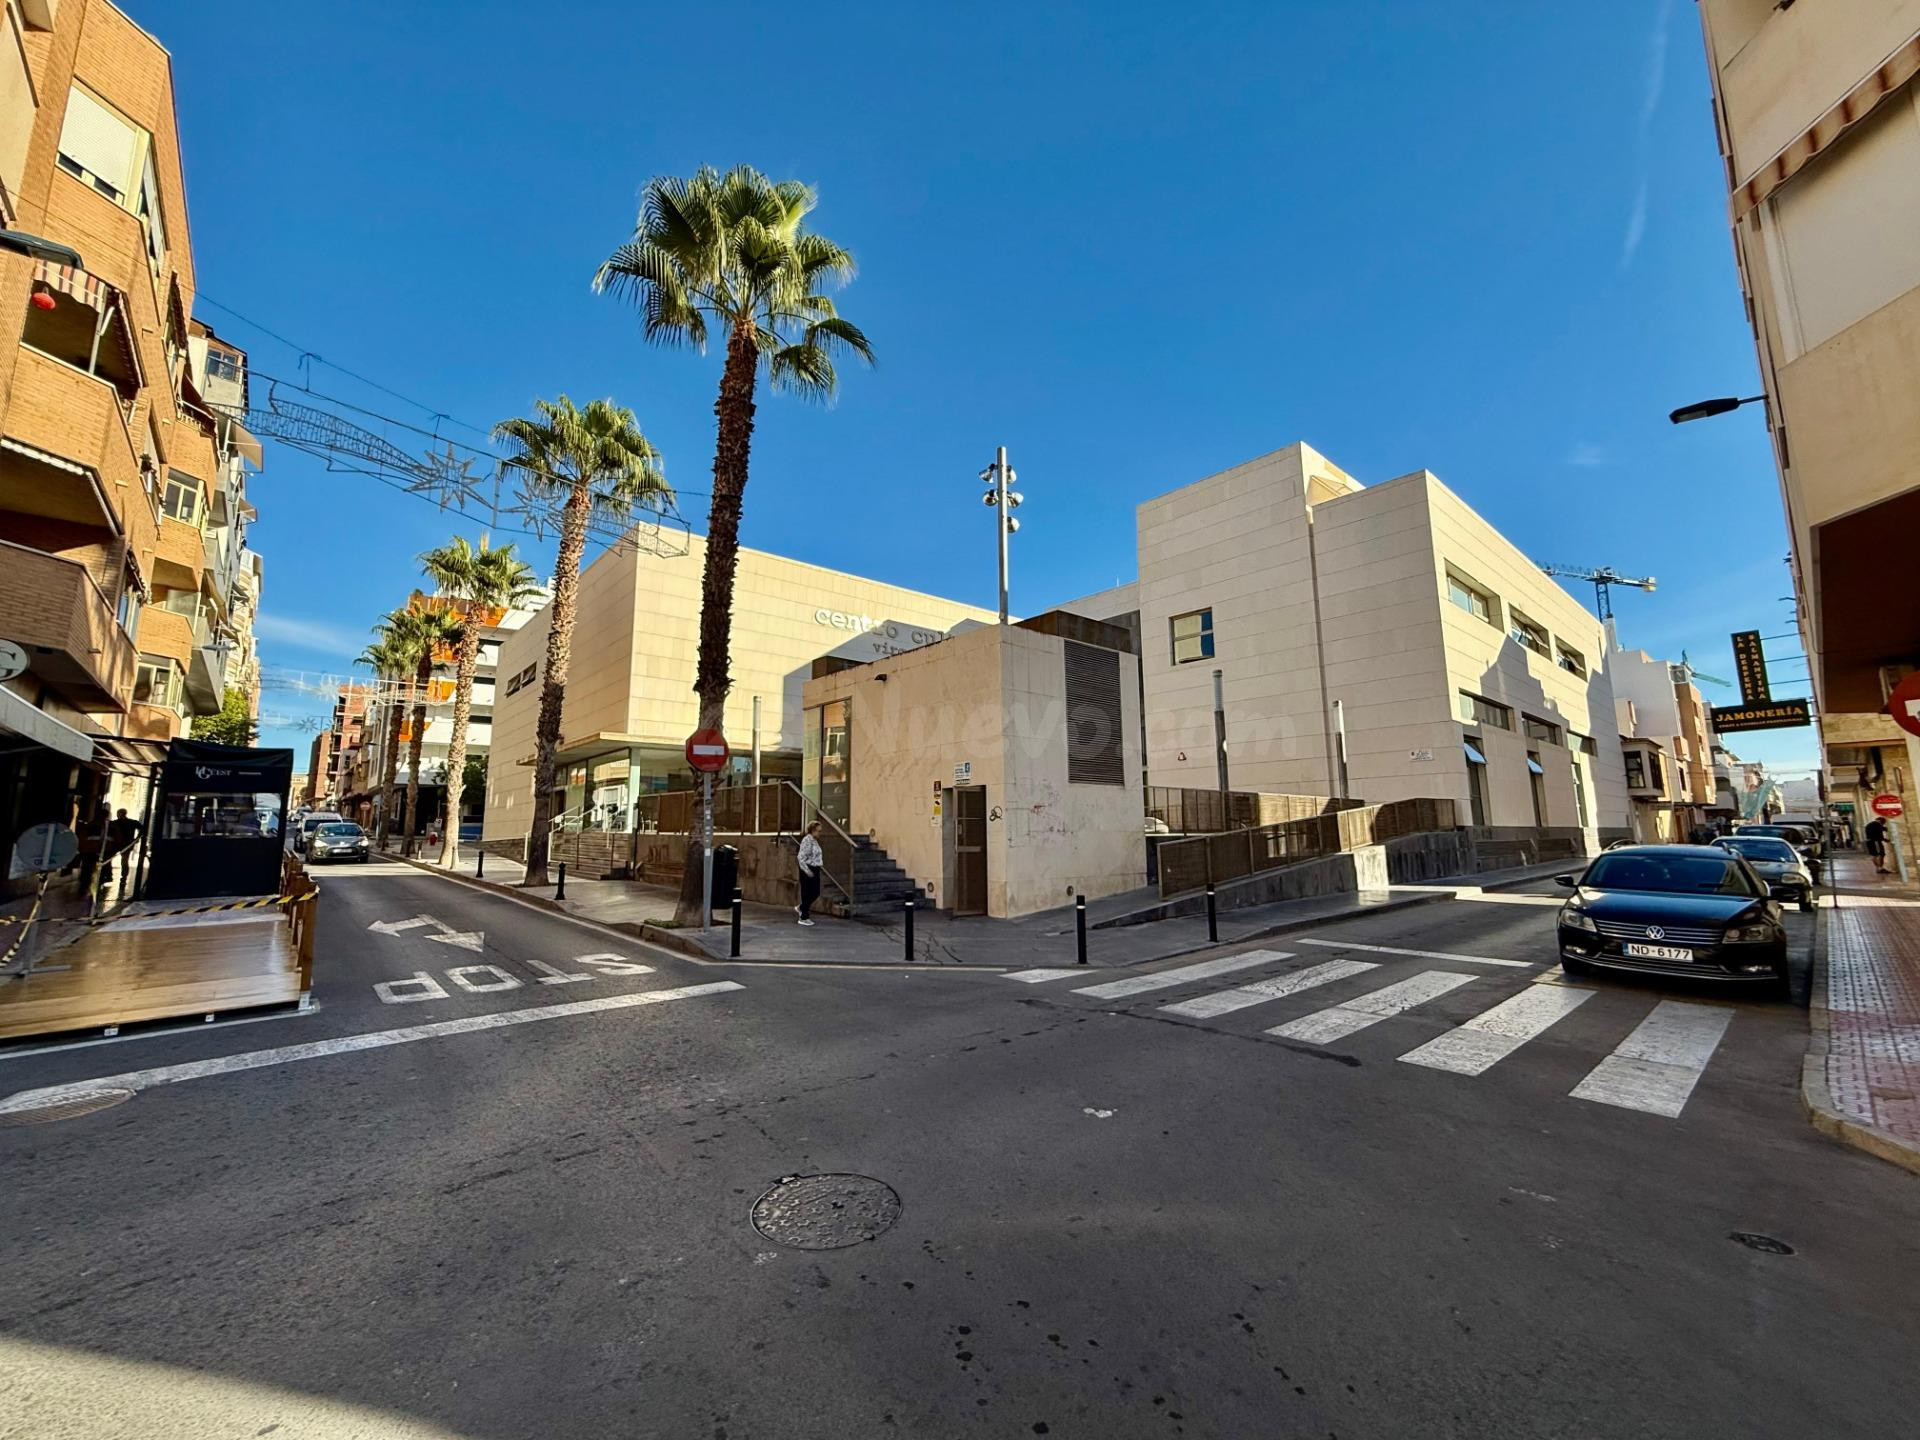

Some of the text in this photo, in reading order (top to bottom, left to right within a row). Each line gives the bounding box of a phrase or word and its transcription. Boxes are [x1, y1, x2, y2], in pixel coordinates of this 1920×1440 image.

[814, 608, 898, 639] centro
[1736, 636, 1744, 648] LA
[1716, 706, 1804, 722] JAMONERÍA
[371, 951, 658, 1005] STOP
